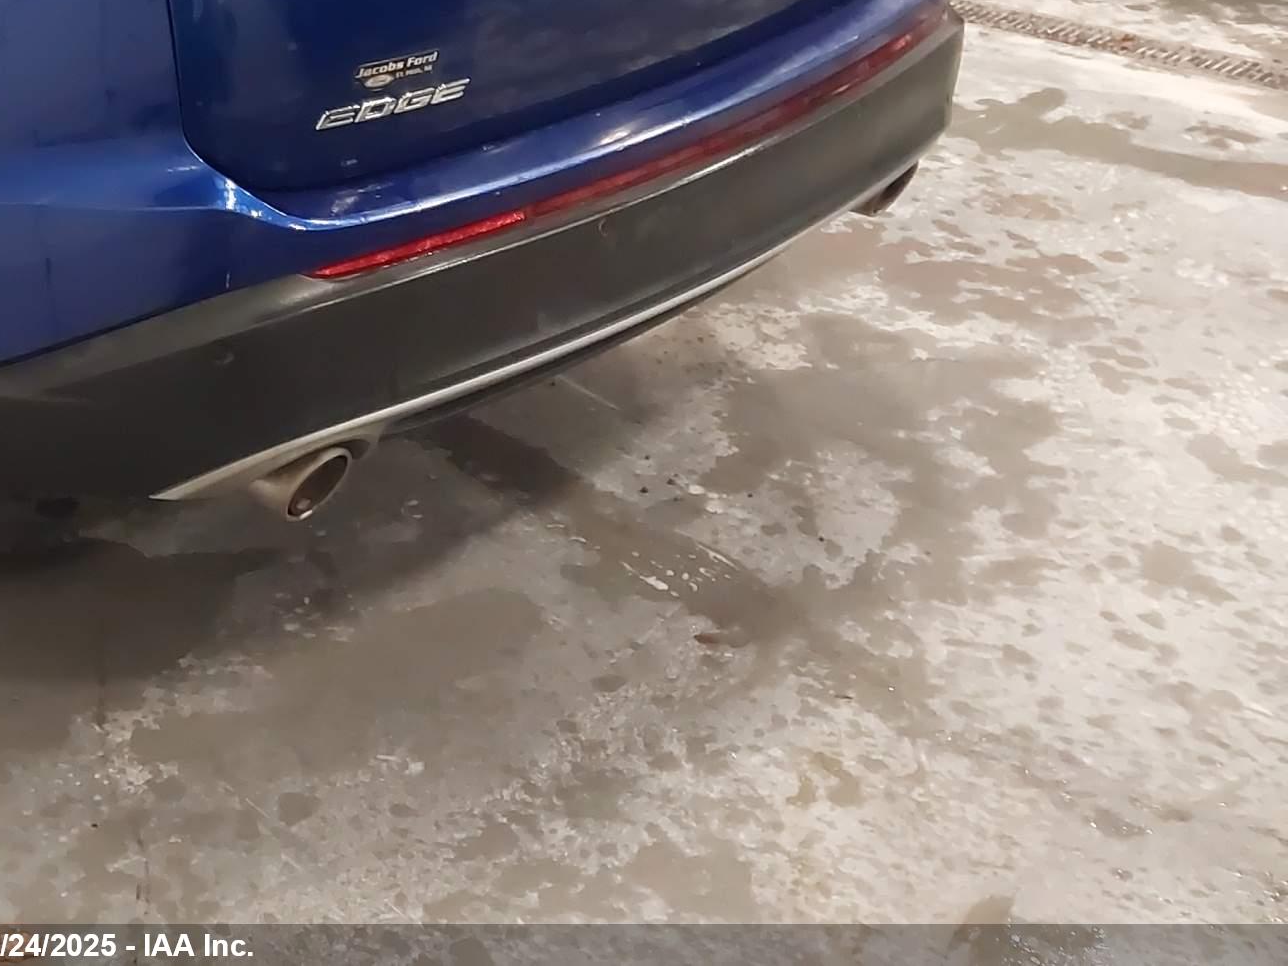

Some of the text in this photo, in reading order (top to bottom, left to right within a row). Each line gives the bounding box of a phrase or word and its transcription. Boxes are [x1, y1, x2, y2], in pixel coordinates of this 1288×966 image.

[355, 60, 404, 79] Jacobs
[406, 50, 439, 68] Ford
[315, 77, 470, 131] EDGE
